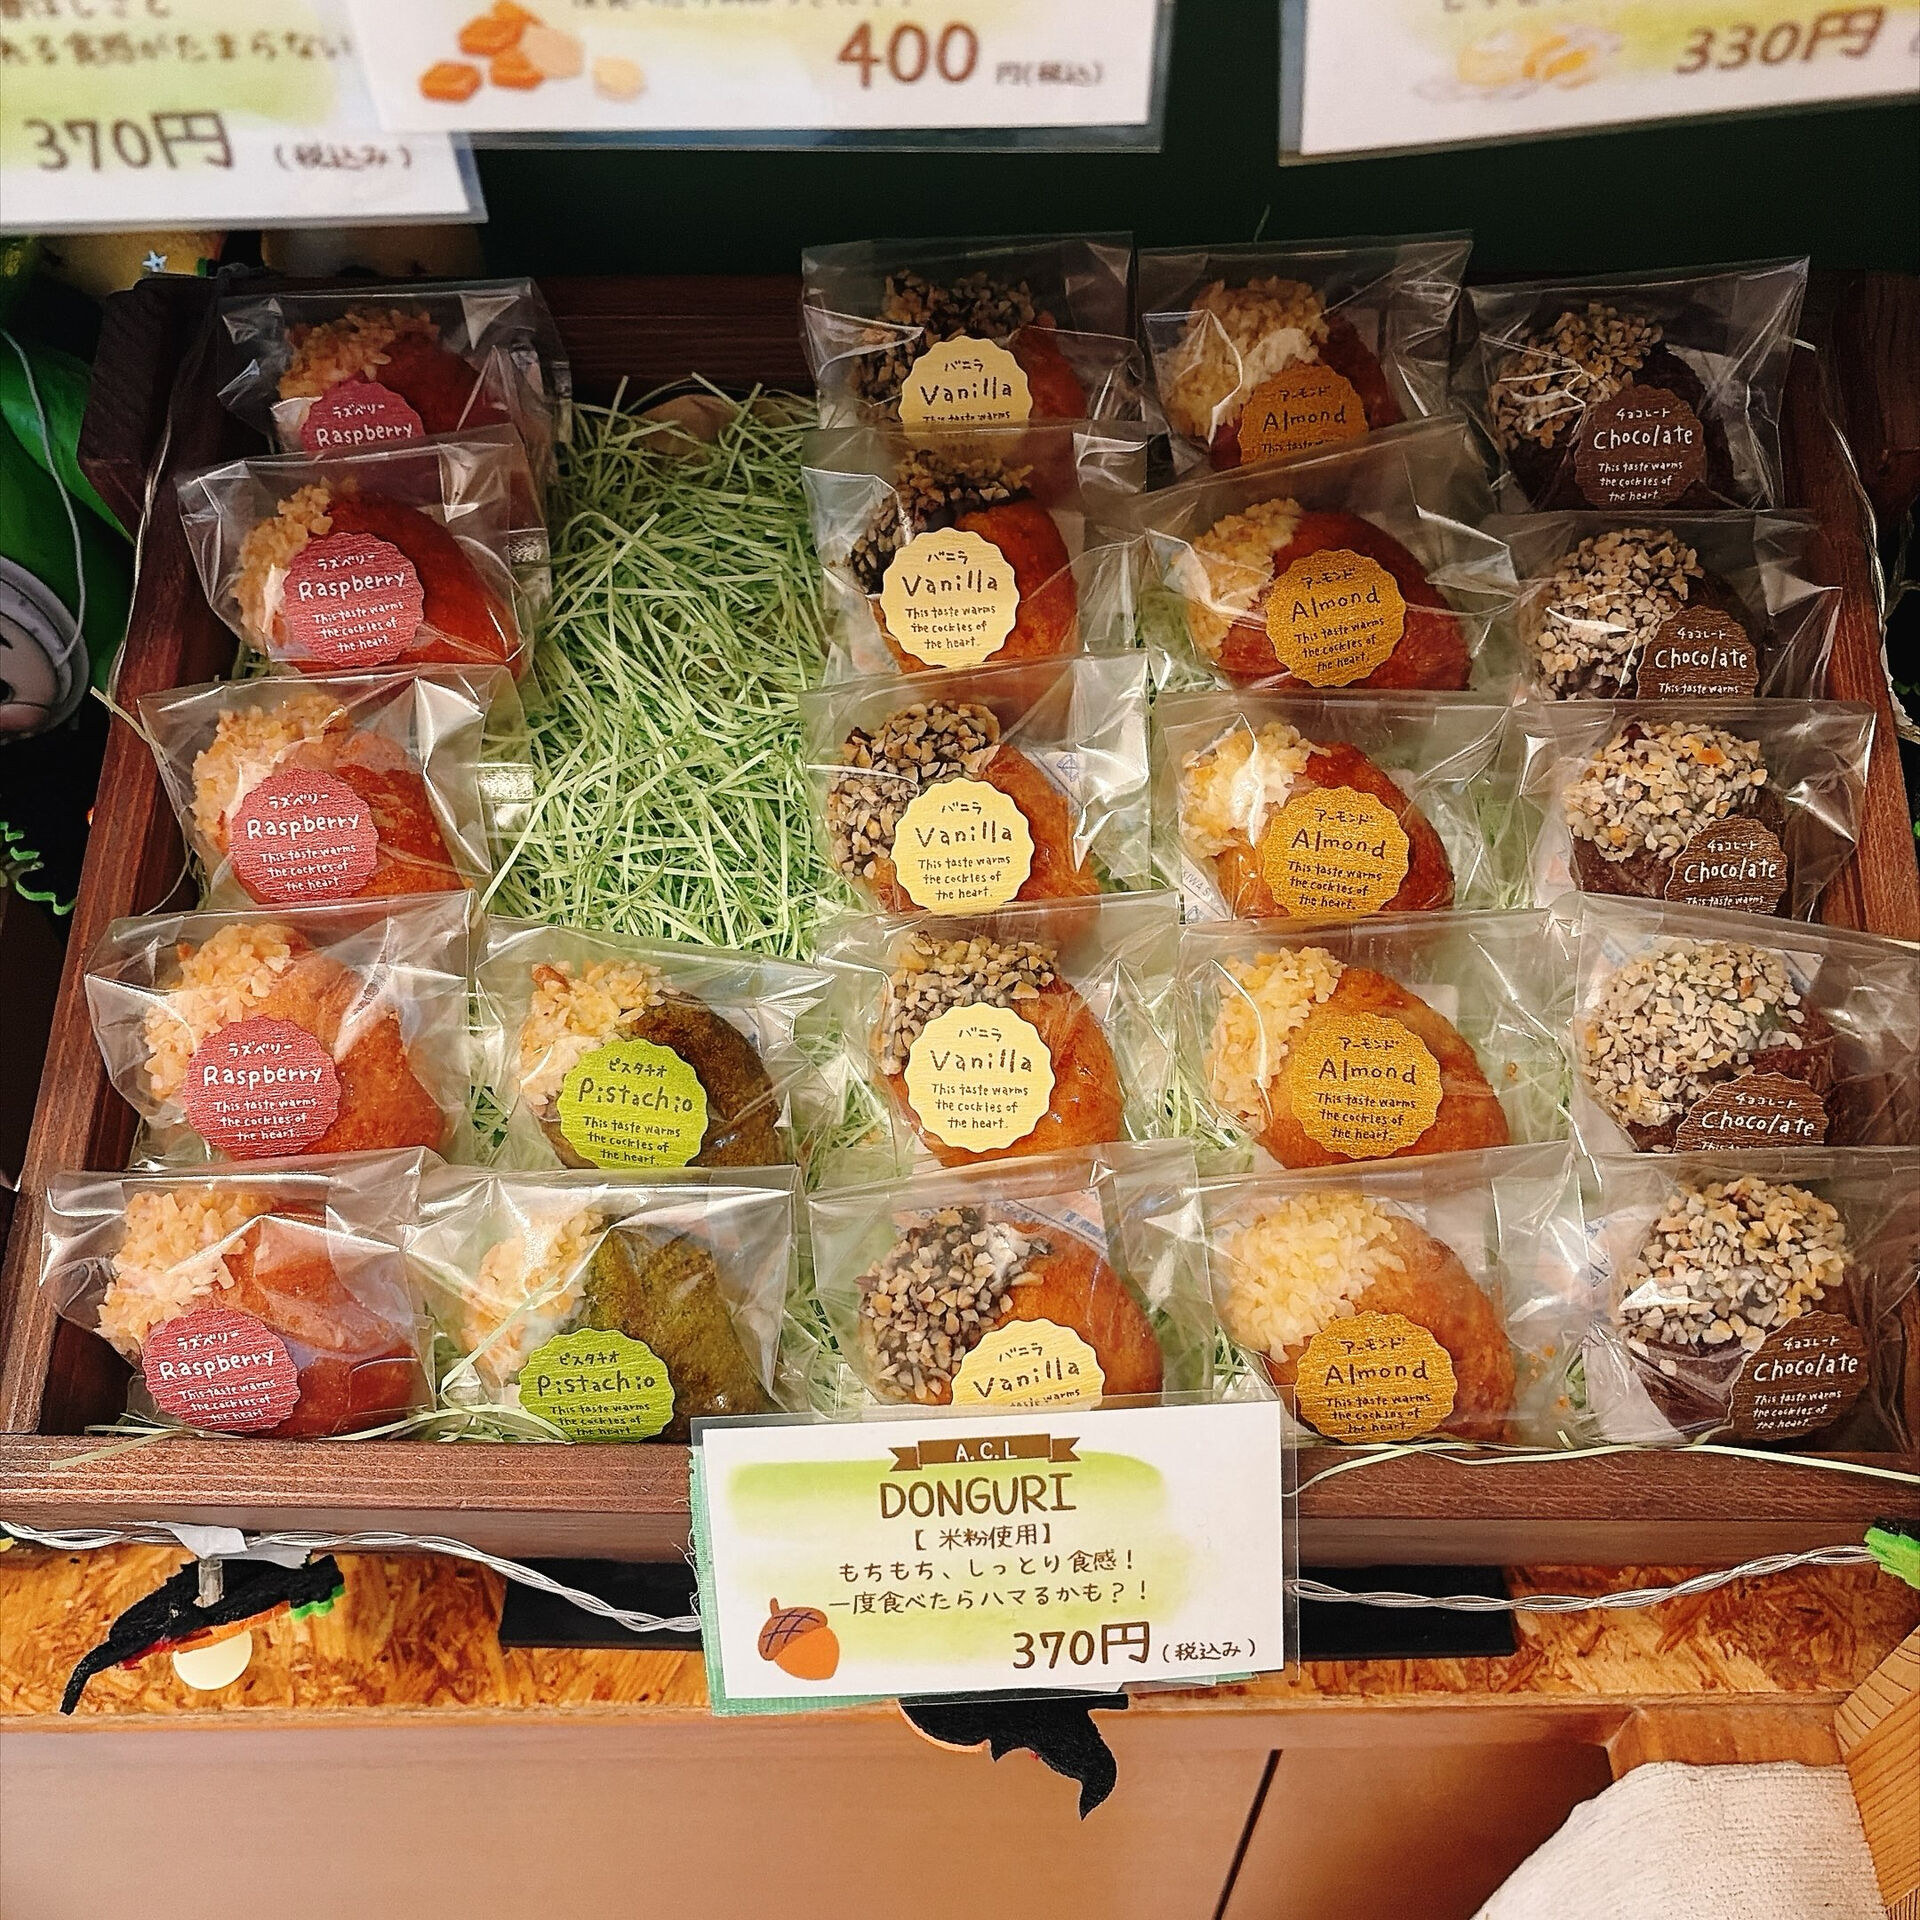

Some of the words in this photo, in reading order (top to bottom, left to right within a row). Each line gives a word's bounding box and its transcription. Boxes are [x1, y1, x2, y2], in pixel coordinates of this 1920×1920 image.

[1675, 5, 1885, 75] 330円
[836, 21, 979, 89] 400
[23, 109, 234, 172] 370円
[944, 359, 984, 372] バニラ
[920, 377, 1012, 406] Vanilla
[333, 401, 384, 418] ラズベリー
[1263, 405, 1346, 432] Almond
[1617, 408, 1670, 420] チョコレート
[316, 423, 412, 446] Raspberry
[1594, 425, 1693, 449] Chocolate
[1598, 462, 1620, 473] This
[1623, 462, 1649, 472] taste
[1651, 462, 1683, 470] warms
[1600, 478, 1617, 486] the
[1619, 477, 1658, 487] cockles
[1661, 475, 1672, 486] of
[318, 554, 375, 570] ラズベリー
[927, 550, 969, 564] バニラ
[299, 572, 404, 601] Raspberry
[902, 569, 998, 597] Vanilla
[1301, 567, 1356, 590] アーモンド
[312, 614, 336, 624] This
[339, 607, 367, 621] taste
[370, 601, 403, 614] warms
[905, 608, 928, 619] This
[931, 606, 959, 618] taste
[962, 605, 996, 615] warms
[1292, 585, 1380, 623] Almond
[386, 617, 397, 628] of
[911, 624, 929, 633] the
[932, 622, 972, 632] cockles
[976, 621, 987, 631] of
[1294, 632, 1318, 644] This
[1321, 625, 1349, 638] taste
[1351, 618, 1384, 632] warms
[1677, 627, 1726, 639] チョコレート
[1302, 646, 1319, 658] the
[1366, 635, 1376, 645] of
[1655, 647, 1747, 669] Chocolate
[1659, 683, 1678, 693] This
[1681, 683, 1707, 694] taste
[1709, 685, 1738, 693] warms
[269, 792, 329, 809] ラズベリー
[941, 801, 982, 814] バニラ
[1315, 808, 1373, 825] アーモンド
[247, 814, 359, 840] Raspberry
[915, 820, 1012, 848] Vanilla
[1291, 828, 1386, 859] Almond
[1707, 840, 1758, 852] チョコレート
[261, 852, 285, 864] This
[288, 847, 317, 860] taste
[320, 844, 356, 857] warms
[918, 860, 942, 870] This
[945, 857, 973, 869] taste
[976, 855, 1010, 866] warms
[268, 867, 287, 878] the
[335, 860, 348, 871] of
[923, 875, 941, 884] the
[944, 873, 986, 883] cockles
[990, 871, 1001, 882] of
[1288, 861, 1311, 873] This
[1315, 863, 1342, 875] taste
[1346, 869, 1382, 881] warms
[1685, 857, 1776, 883] Chocolate
[936, 890, 954, 900] the
[1290, 877, 1307, 887] the
[1310, 880, 1353, 894] cockles
[1357, 886, 1368, 896] of
[1299, 894, 1316, 905] the
[959, 1027, 1002, 1042] バニラ
[1339, 1036, 1399, 1051] アーモンド
[228, 1041, 292, 1057] ラズベリー
[609, 1057, 667, 1078] ピスタチオ
[930, 1049, 1032, 1073] Vanilla
[203, 1065, 322, 1090] Raspberry
[1319, 1058, 1416, 1085] Almond
[578, 1078, 693, 1112] Pistachio
[931, 1083, 955, 1095] This
[959, 1084, 988, 1095] taste
[992, 1086, 1028, 1096] warms
[213, 1101, 240, 1113] This
[245, 1100, 275, 1111] taste
[279, 1098, 316, 1108] warms
[936, 1100, 954, 1111] the
[958, 1102, 1002, 1113] cockles
[1006, 1102, 1018, 1113] of
[1315, 1092, 1342, 1105] This
[1345, 1094, 1376, 1107] taste
[1379, 1099, 1416, 1108] warms
[1735, 1092, 1797, 1109] チョコレート
[220, 1116, 240, 1127] the
[244, 1115, 290, 1126] cockles
[296, 1113, 307, 1123] of
[948, 1118, 967, 1129] the
[1320, 1109, 1338, 1120] the
[1342, 1112, 1388, 1124] cockles
[1392, 1114, 1404, 1125] of
[1702, 1110, 1815, 1136] Chocolate
[583, 1116, 608, 1129] This
[612, 1120, 641, 1133] taste
[645, 1126, 680, 1138] warms
[588, 1132, 606, 1144] the
[610, 1136, 653, 1150] cockles
[657, 1142, 669, 1153] of
[601, 1150, 619, 1160] the
[1000, 1343, 1043, 1362] バニラ
[1341, 1337, 1405, 1354] アーモンド
[1783, 1336, 1840, 1350] チョコレート
[158, 1350, 275, 1380] Raspberry
[560, 1350, 620, 1366] ピスタチオ
[1754, 1353, 1858, 1381] Chocolate
[973, 1357, 1080, 1397] Vanilla
[1325, 1360, 1428, 1386] Almond
[537, 1370, 656, 1397] Pistachio
[178, 1391, 204, 1401] This
[208, 1386, 237, 1397] taste
[1325, 1398, 1351, 1407] This
[1356, 1397, 1387, 1407] taste
[1392, 1394, 1431, 1403] warms
[1755, 1395, 1776, 1405] This
[1780, 1393, 1807, 1404] taste
[1810, 1391, 1841, 1400] warms
[550, 1406, 576, 1415] This
[580, 1406, 608, 1414] taste
[613, 1403, 650, 1412] warms
[1407, 1408, 1421, 1419] of
[955, 1440, 1018, 1462] A.C.L
[879, 1472, 1078, 1519] DONGURI
[913, 1523, 1052, 1551] 【米粉使用】
[838, 1549, 1134, 1583] もちもち、しっとり食感！
[828, 1580, 1148, 1617] 一度食べたらハマるかも？！
[1013, 1621, 1150, 1668] 370円
[1162, 1639, 1256, 1663] （税込み）
